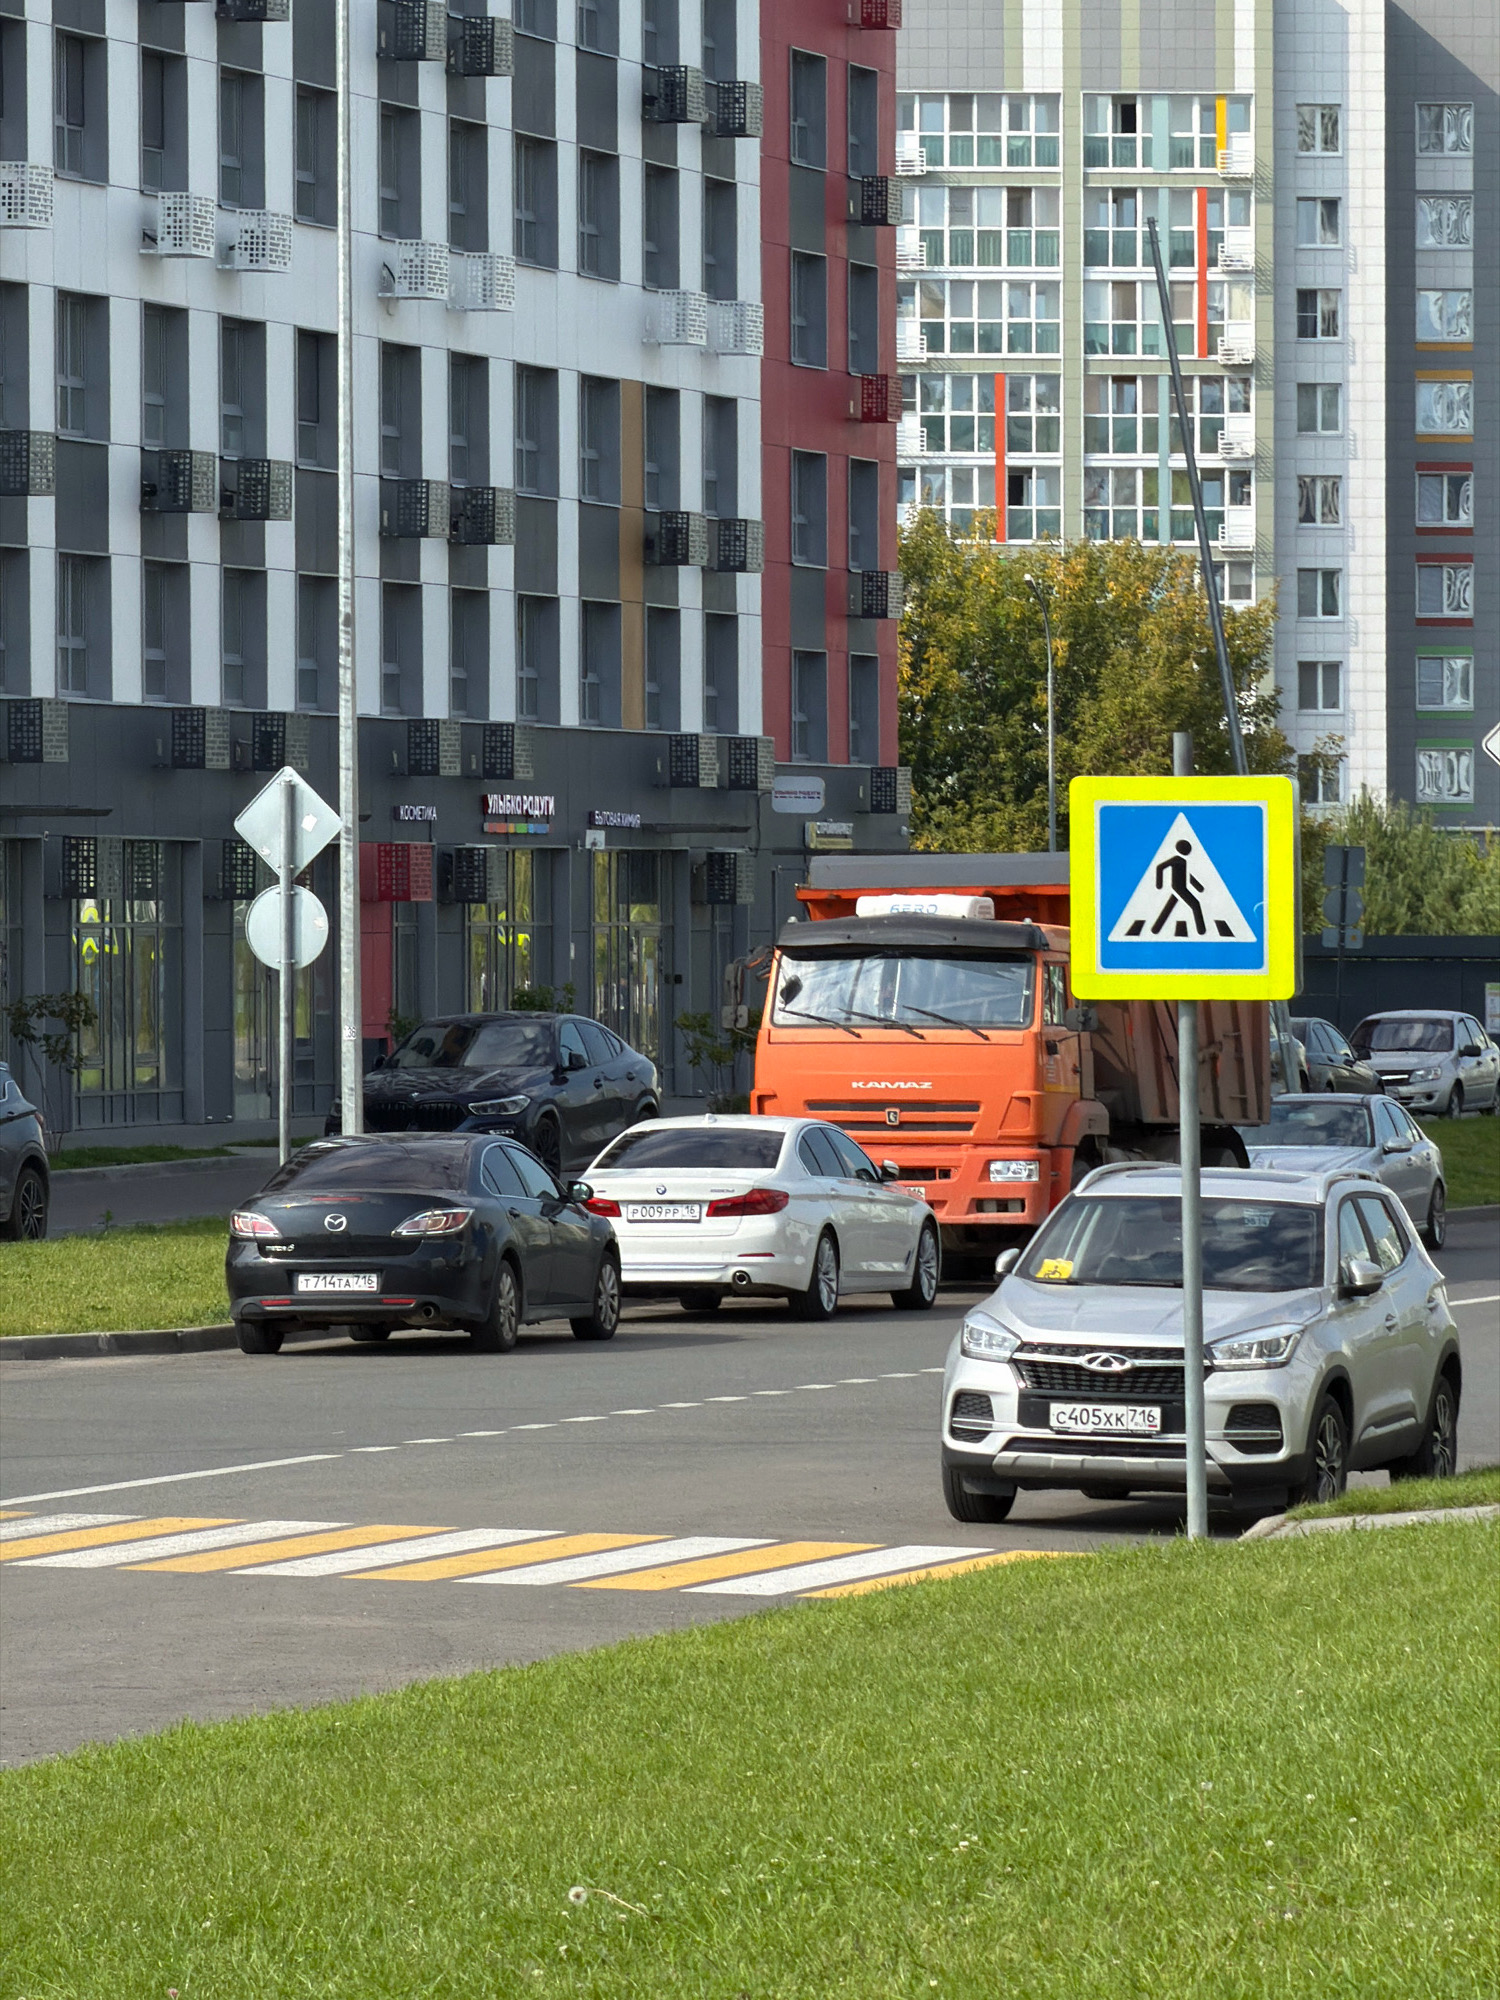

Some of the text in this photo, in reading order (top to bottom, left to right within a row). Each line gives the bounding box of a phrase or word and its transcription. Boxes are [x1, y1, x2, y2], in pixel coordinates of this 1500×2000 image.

[400, 805, 437, 821] КОСМЕТИКА
[487, 794, 555, 818] УЛЫБКА РАДУГИ
[595, 810, 621, 827] БЫТОВАЯ
[852, 1081, 932, 1089] KAMAZ
[1129, 1408, 1156, 1423] 716
